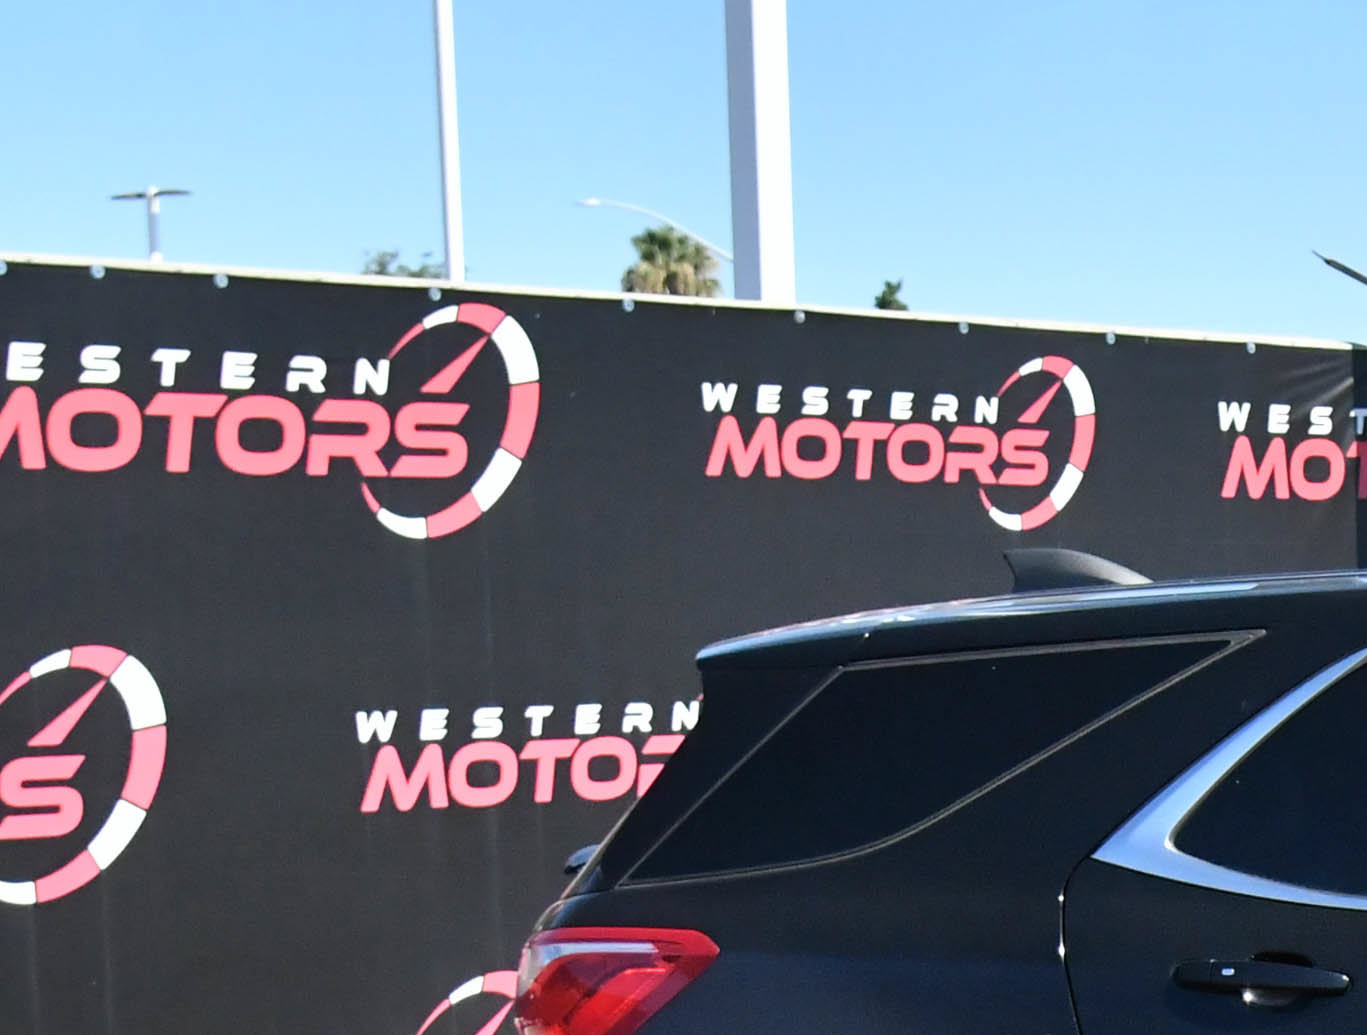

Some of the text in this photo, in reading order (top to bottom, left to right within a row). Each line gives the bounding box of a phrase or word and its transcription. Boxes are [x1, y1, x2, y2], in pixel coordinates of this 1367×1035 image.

[701, 382, 999, 425] WESTERN
[704, 415, 1051, 487] MOTORS
[355, 700, 700, 744] WESTERN
